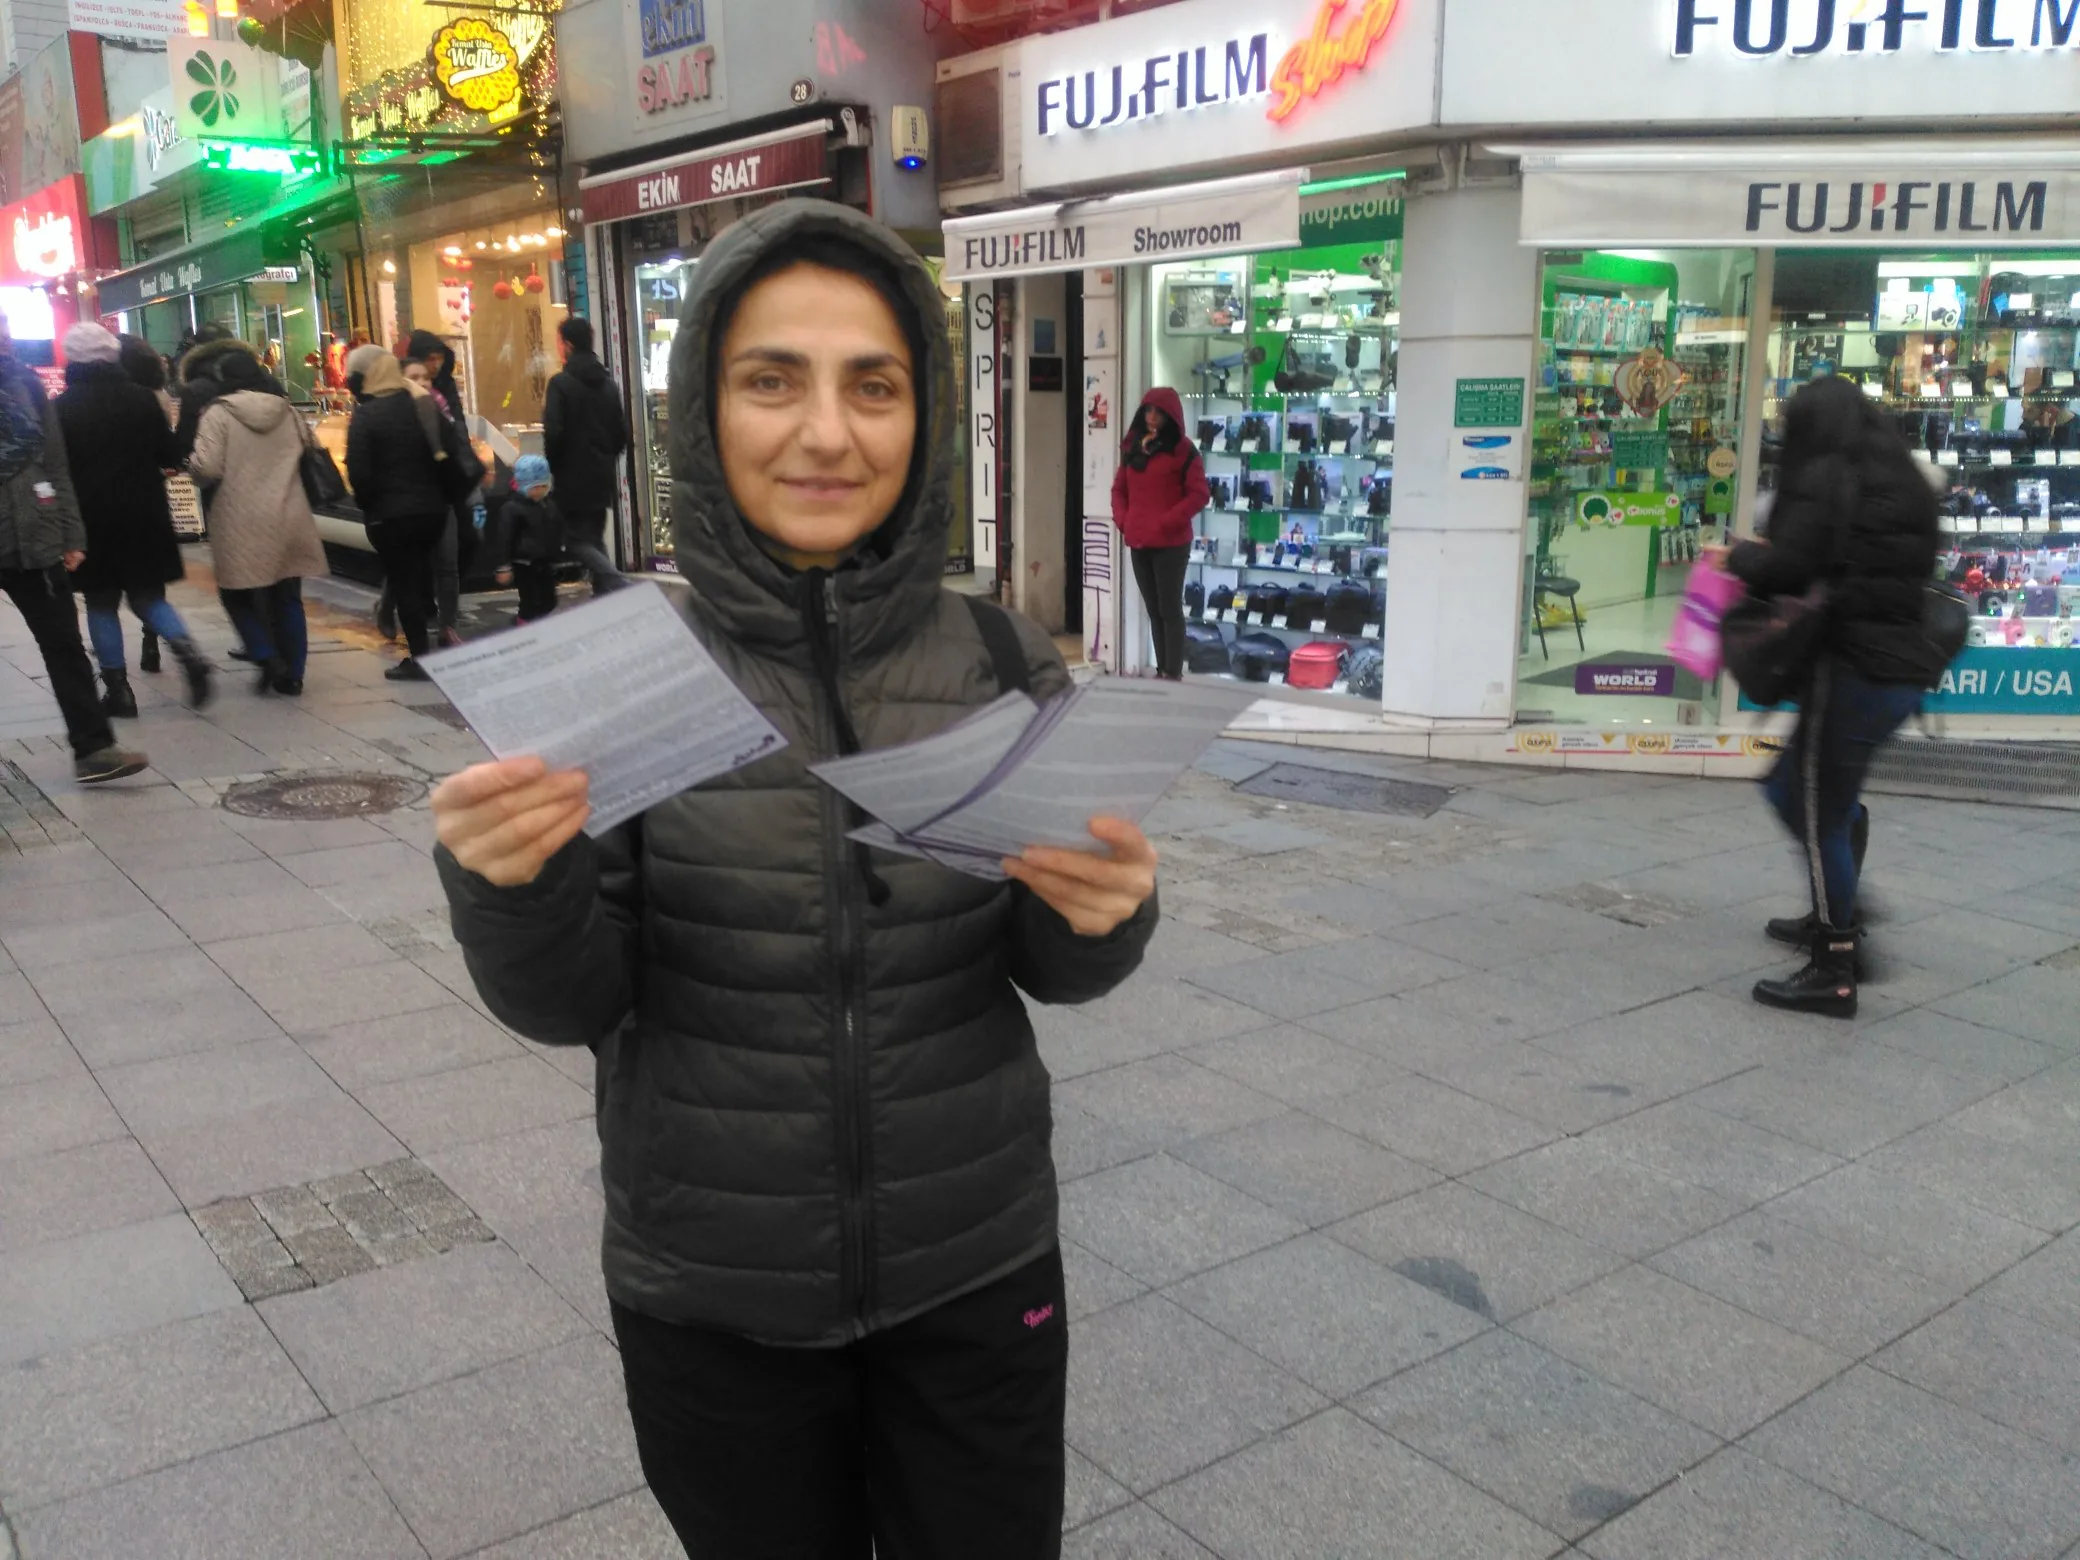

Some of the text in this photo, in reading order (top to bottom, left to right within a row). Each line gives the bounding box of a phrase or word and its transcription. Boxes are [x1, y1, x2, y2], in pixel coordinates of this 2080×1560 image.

[1673, 0, 2080, 56] FUJIFILM
[447, 46, 508, 71] Waffles
[638, 45, 715, 113] SAAT
[794, 84, 807, 101] 28
[1037, 33, 1268, 136] FUJIFILM
[638, 155, 761, 209] EKİN SAAT
[1745, 182, 2047, 233] FUJIFILM
[965, 221, 1242, 269] FUJIFILM Showroom
[1593, 674, 1657, 687] WORLD
[1925, 669, 1987, 695] ARI
[2012, 670, 2073, 696] USA
